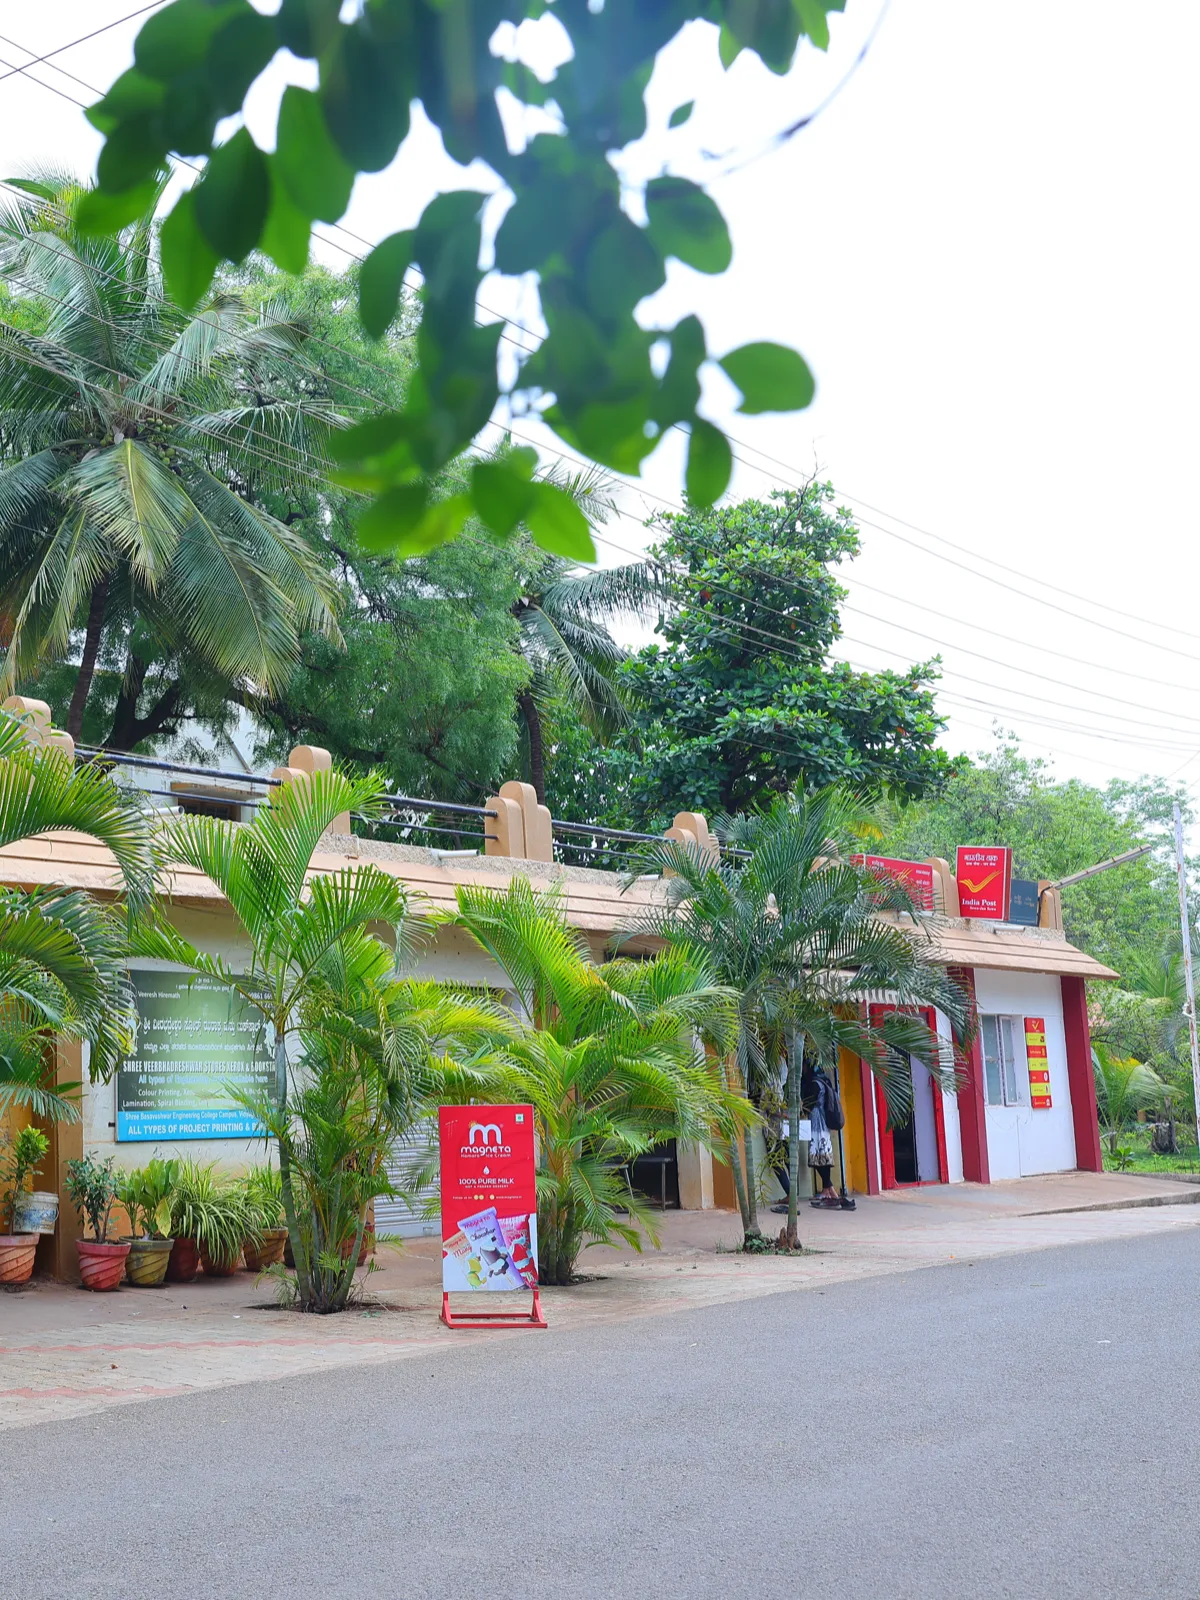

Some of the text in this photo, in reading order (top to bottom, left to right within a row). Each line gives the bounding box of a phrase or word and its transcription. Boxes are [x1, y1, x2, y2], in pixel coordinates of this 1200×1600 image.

[123, 1060, 142, 1072] SHREE
[204, 1060, 226, 1073] STORES
[227, 1060, 244, 1072] XEROX
[246, 1061, 249, 1072] &
[139, 1074, 147, 1084] All
[149, 1074, 165, 1085] types
[167, 1074, 173, 1083] of
[255, 1074, 268, 1083] here
[138, 1088, 157, 1096] Colour
[123, 1099, 157, 1108] Lamination,
[158, 1099, 173, 1108] Spiral
[125, 1112, 139, 1120] Shree
[172, 1112, 200, 1121] Engineering
[201, 1111, 218, 1119] College
[128, 1125, 142, 1135] ALL
[143, 1124, 167, 1134] TYPES
[168, 1124, 178, 1134] OF
[179, 1123, 211, 1133] PROJECT
[212, 1122, 244, 1132] PRINTING
[245, 1122, 250, 1131] &
